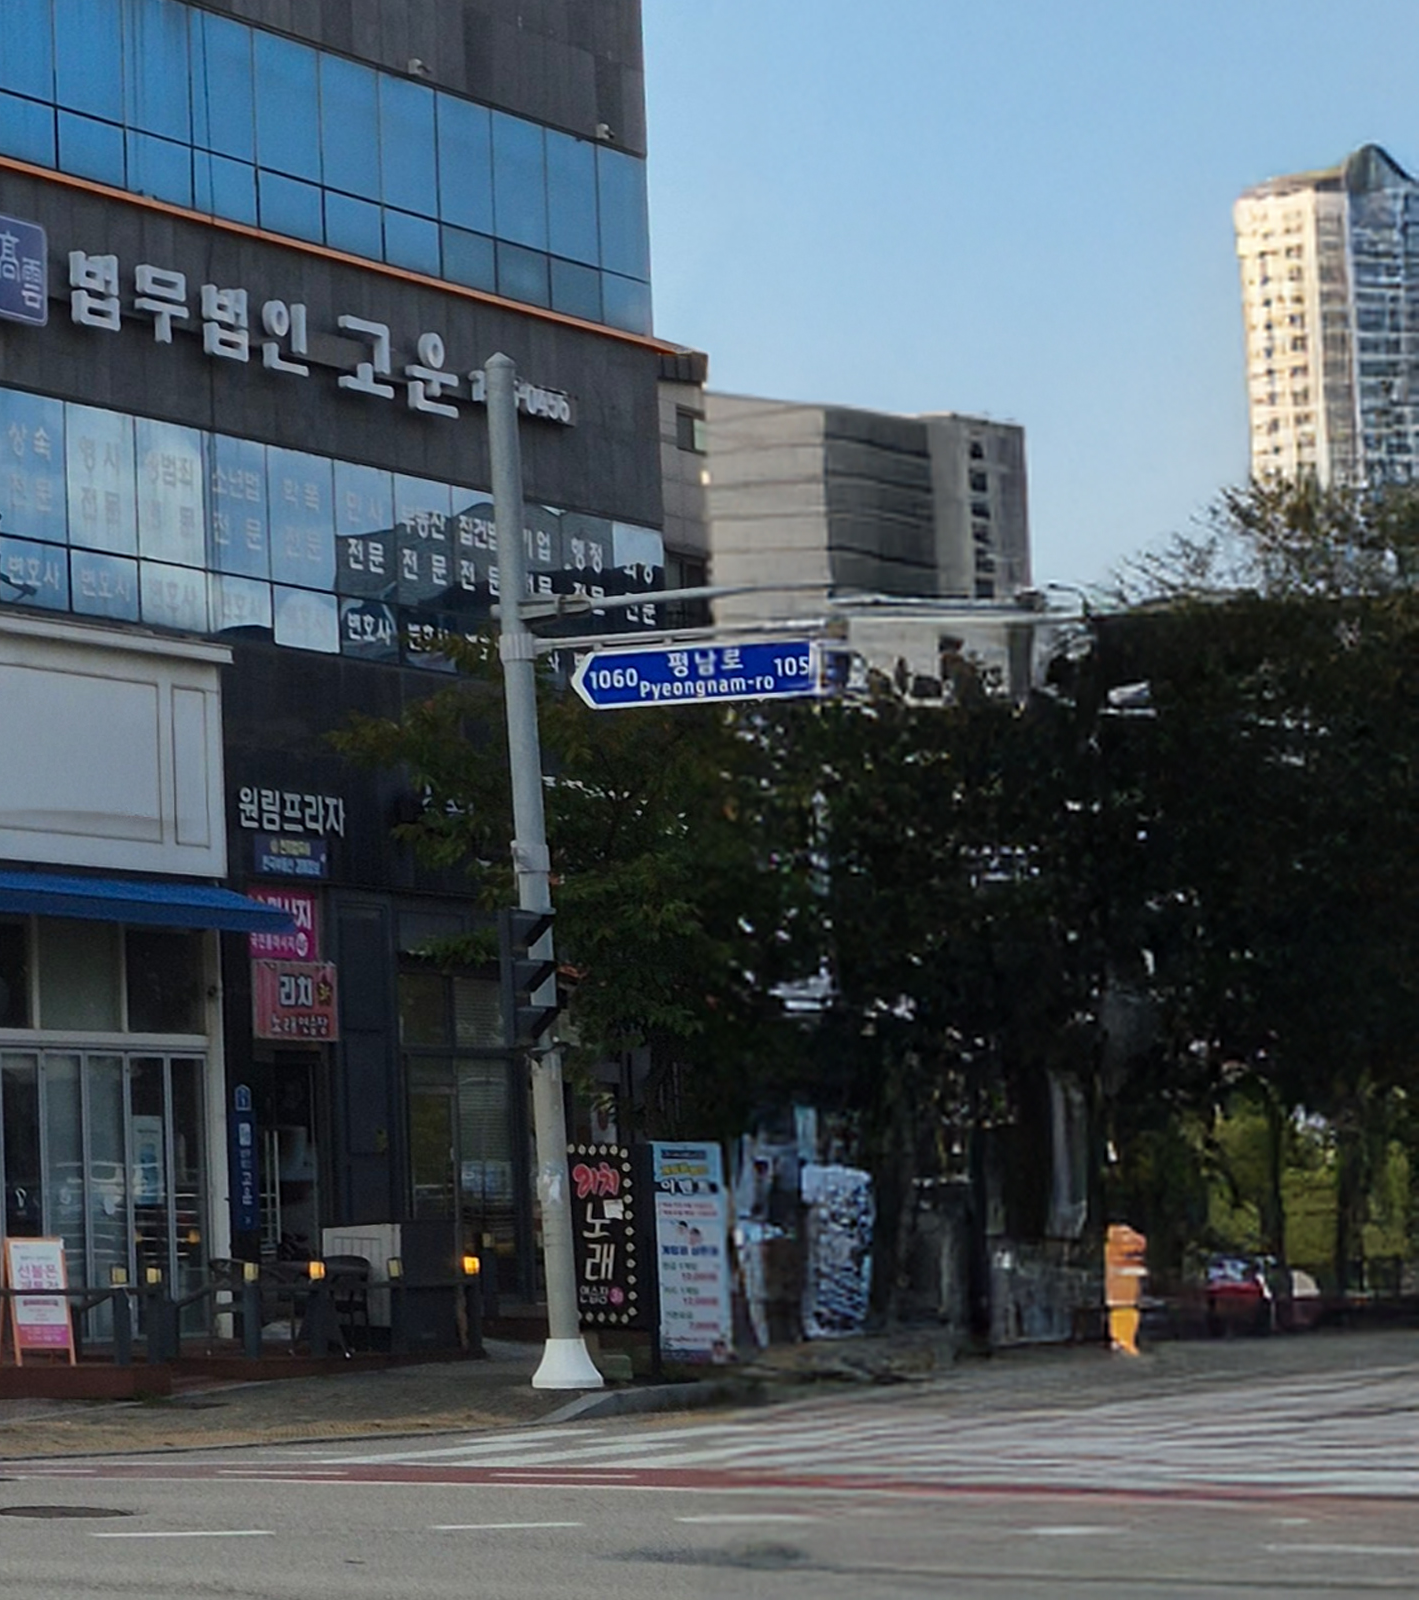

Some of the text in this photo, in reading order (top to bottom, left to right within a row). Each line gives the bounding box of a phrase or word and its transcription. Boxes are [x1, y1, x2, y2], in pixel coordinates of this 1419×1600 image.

[67, 249, 309, 377] 법무법인
[337, 313, 460, 419] 고운
[213, 511, 262, 551] 전문
[8, 556, 60, 590] 변호사
[347, 537, 385, 575] 전문
[402, 549, 447, 586] 전문
[571, 536, 604, 574] 행정
[347, 611, 392, 646] 변호사
[668, 648, 744, 678] 평남로
[588, 668, 639, 690] 1060
[639, 675, 775, 701] Pyeongnam-ro
[239, 786, 345, 838] 원림프라자
